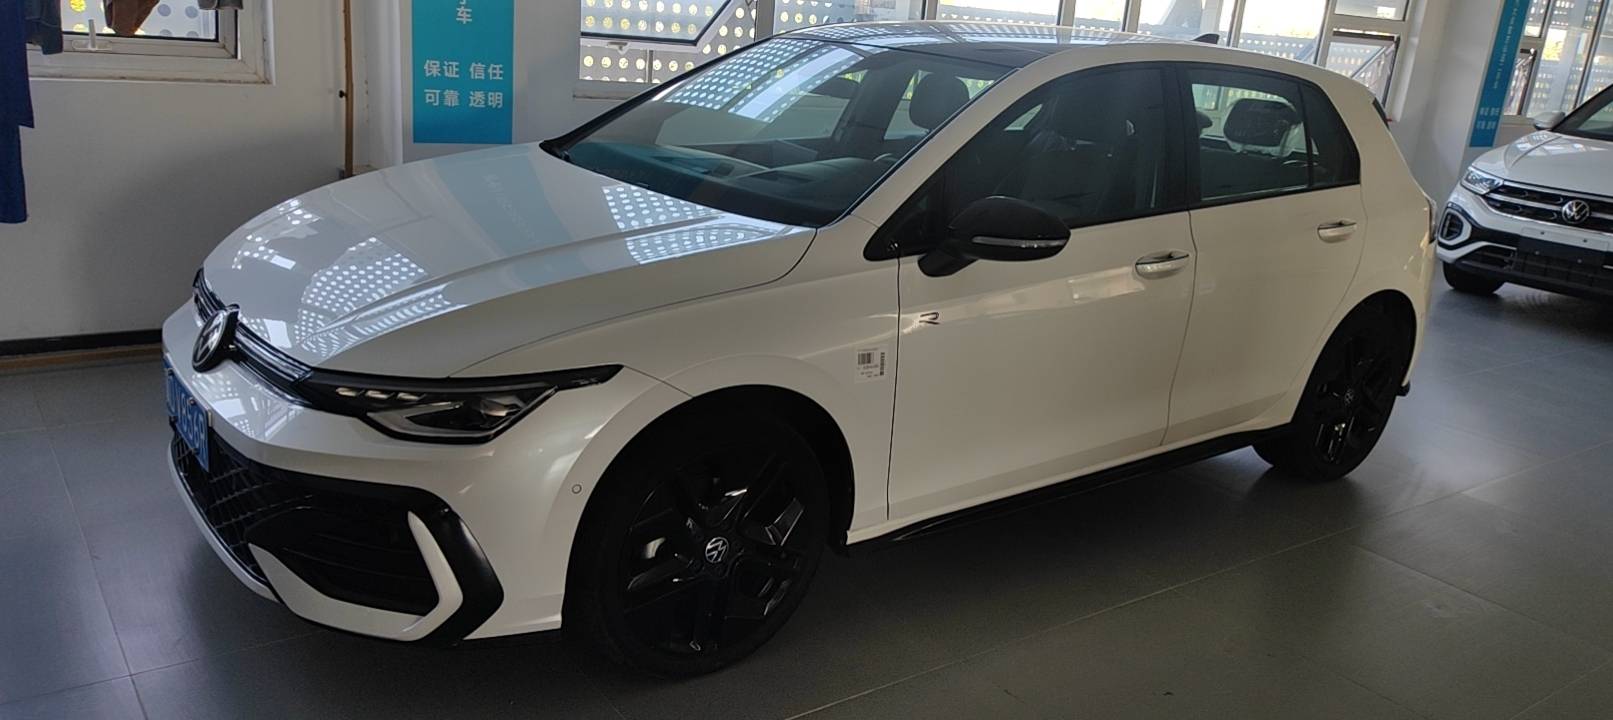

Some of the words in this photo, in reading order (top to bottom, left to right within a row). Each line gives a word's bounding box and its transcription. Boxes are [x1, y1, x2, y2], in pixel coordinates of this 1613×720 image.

[455, 0, 473, 25] 车
[424, 59, 460, 79] 保证
[469, 62, 504, 81] 信任
[424, 88, 460, 107] 可靠
[469, 90, 504, 109] 透明
